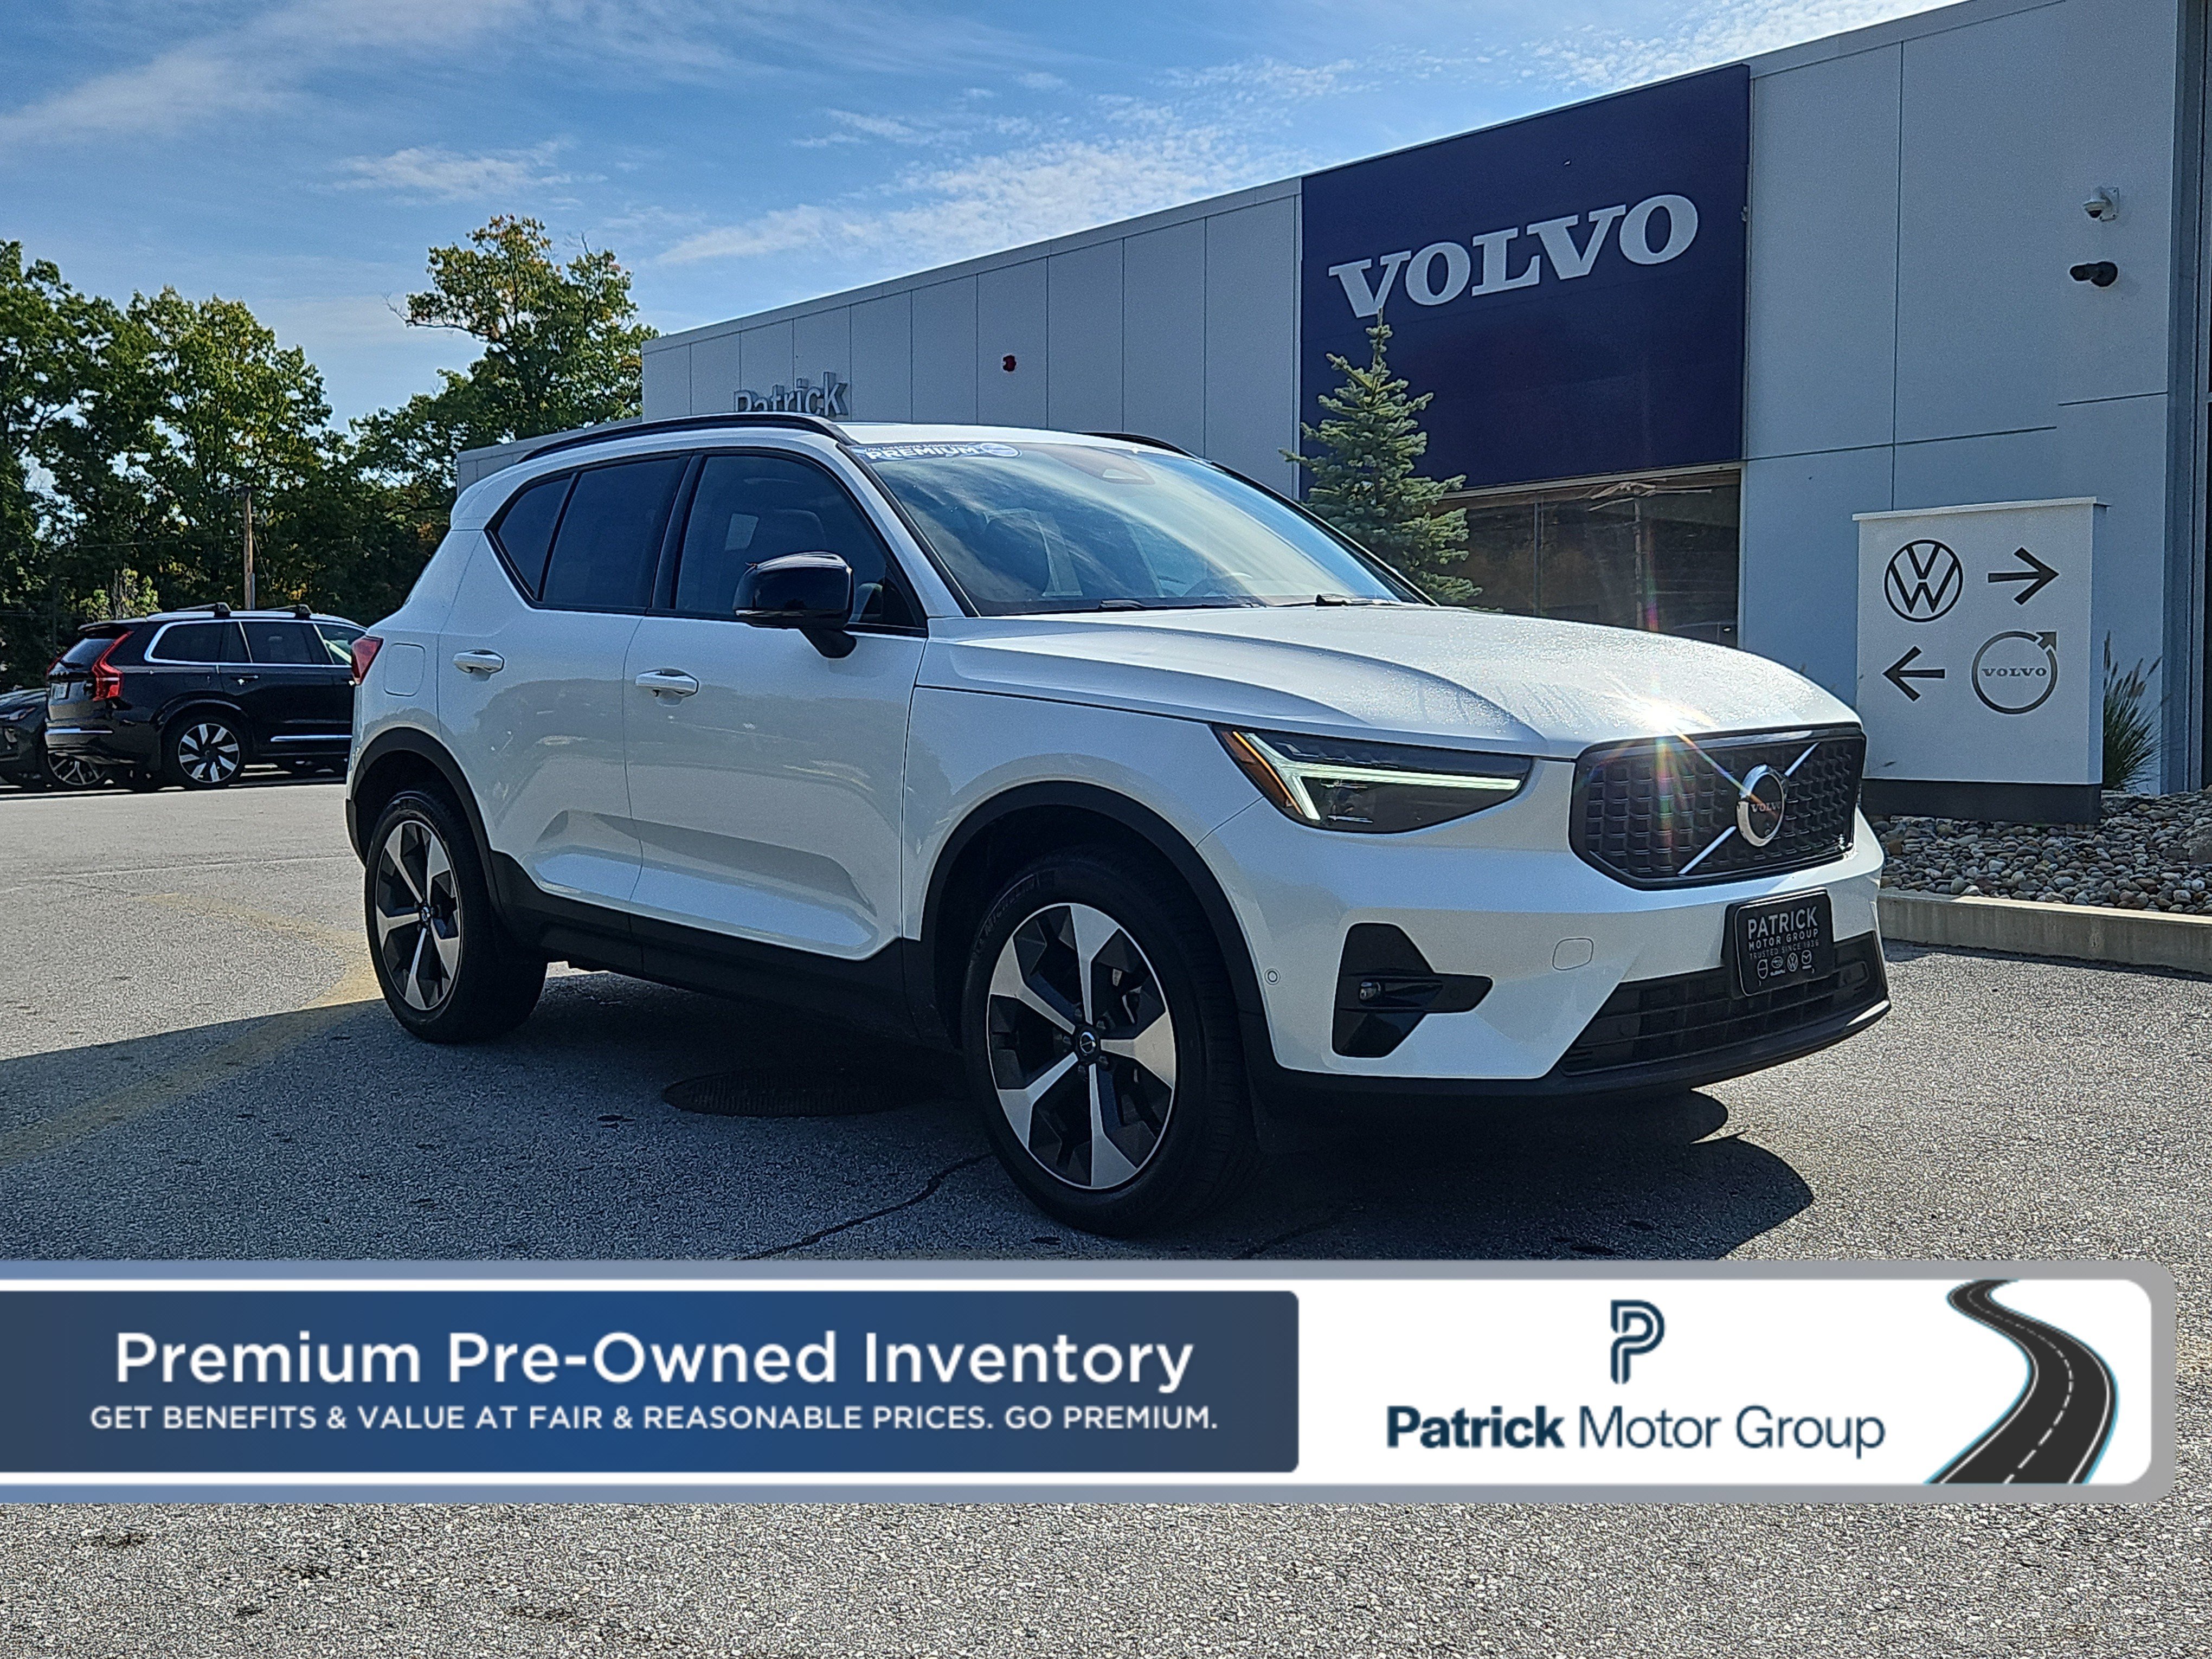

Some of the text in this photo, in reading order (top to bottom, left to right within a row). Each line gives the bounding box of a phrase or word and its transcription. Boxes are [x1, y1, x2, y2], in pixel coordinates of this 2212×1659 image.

[1328, 194, 1698, 318] VOLVO
[867, 446, 980, 460] PREMIUM
[1981, 667, 2048, 677] VOLVO
[1747, 906, 1818, 940] PATRICK
[1748, 929, 1818, 951] MOTOR GROUP
[1750, 948, 1779, 960] TRUSTED
[1782, 942, 1801, 954] SINCE
